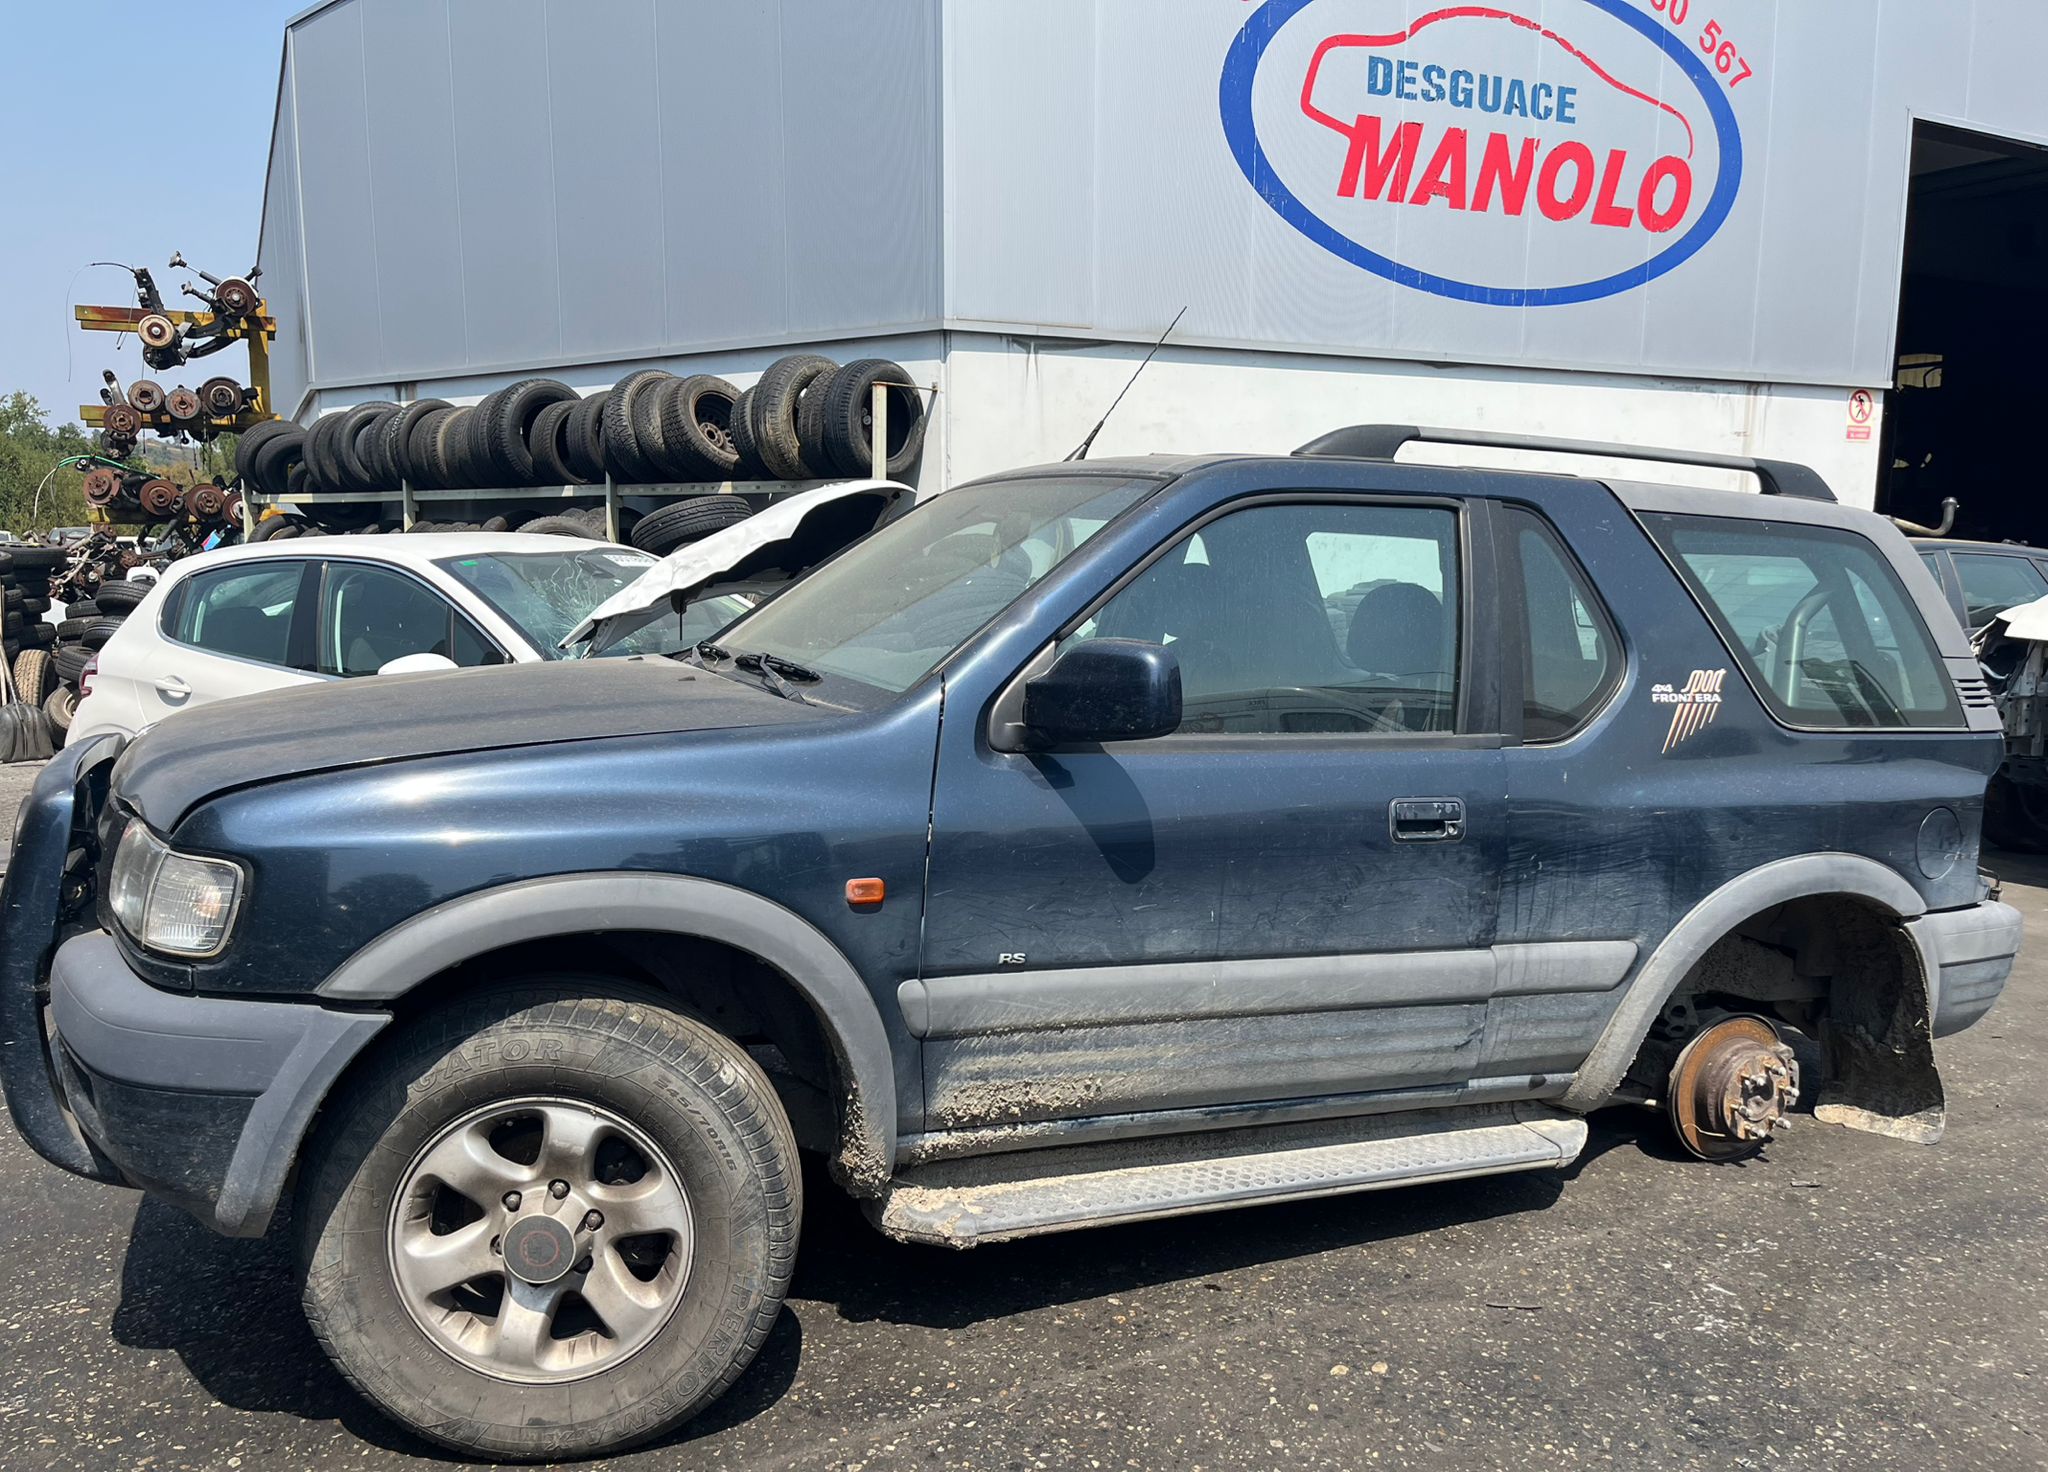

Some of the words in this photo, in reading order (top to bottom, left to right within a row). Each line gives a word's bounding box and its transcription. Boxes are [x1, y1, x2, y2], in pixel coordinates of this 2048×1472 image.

[1699, 19, 1752, 88] 567
[1367, 55, 1577, 124] DESGUACE
[1337, 113, 1693, 233] MANOLO
[1651, 693, 1722, 702] FRONTERA
[998, 952, 1026, 964] RS
